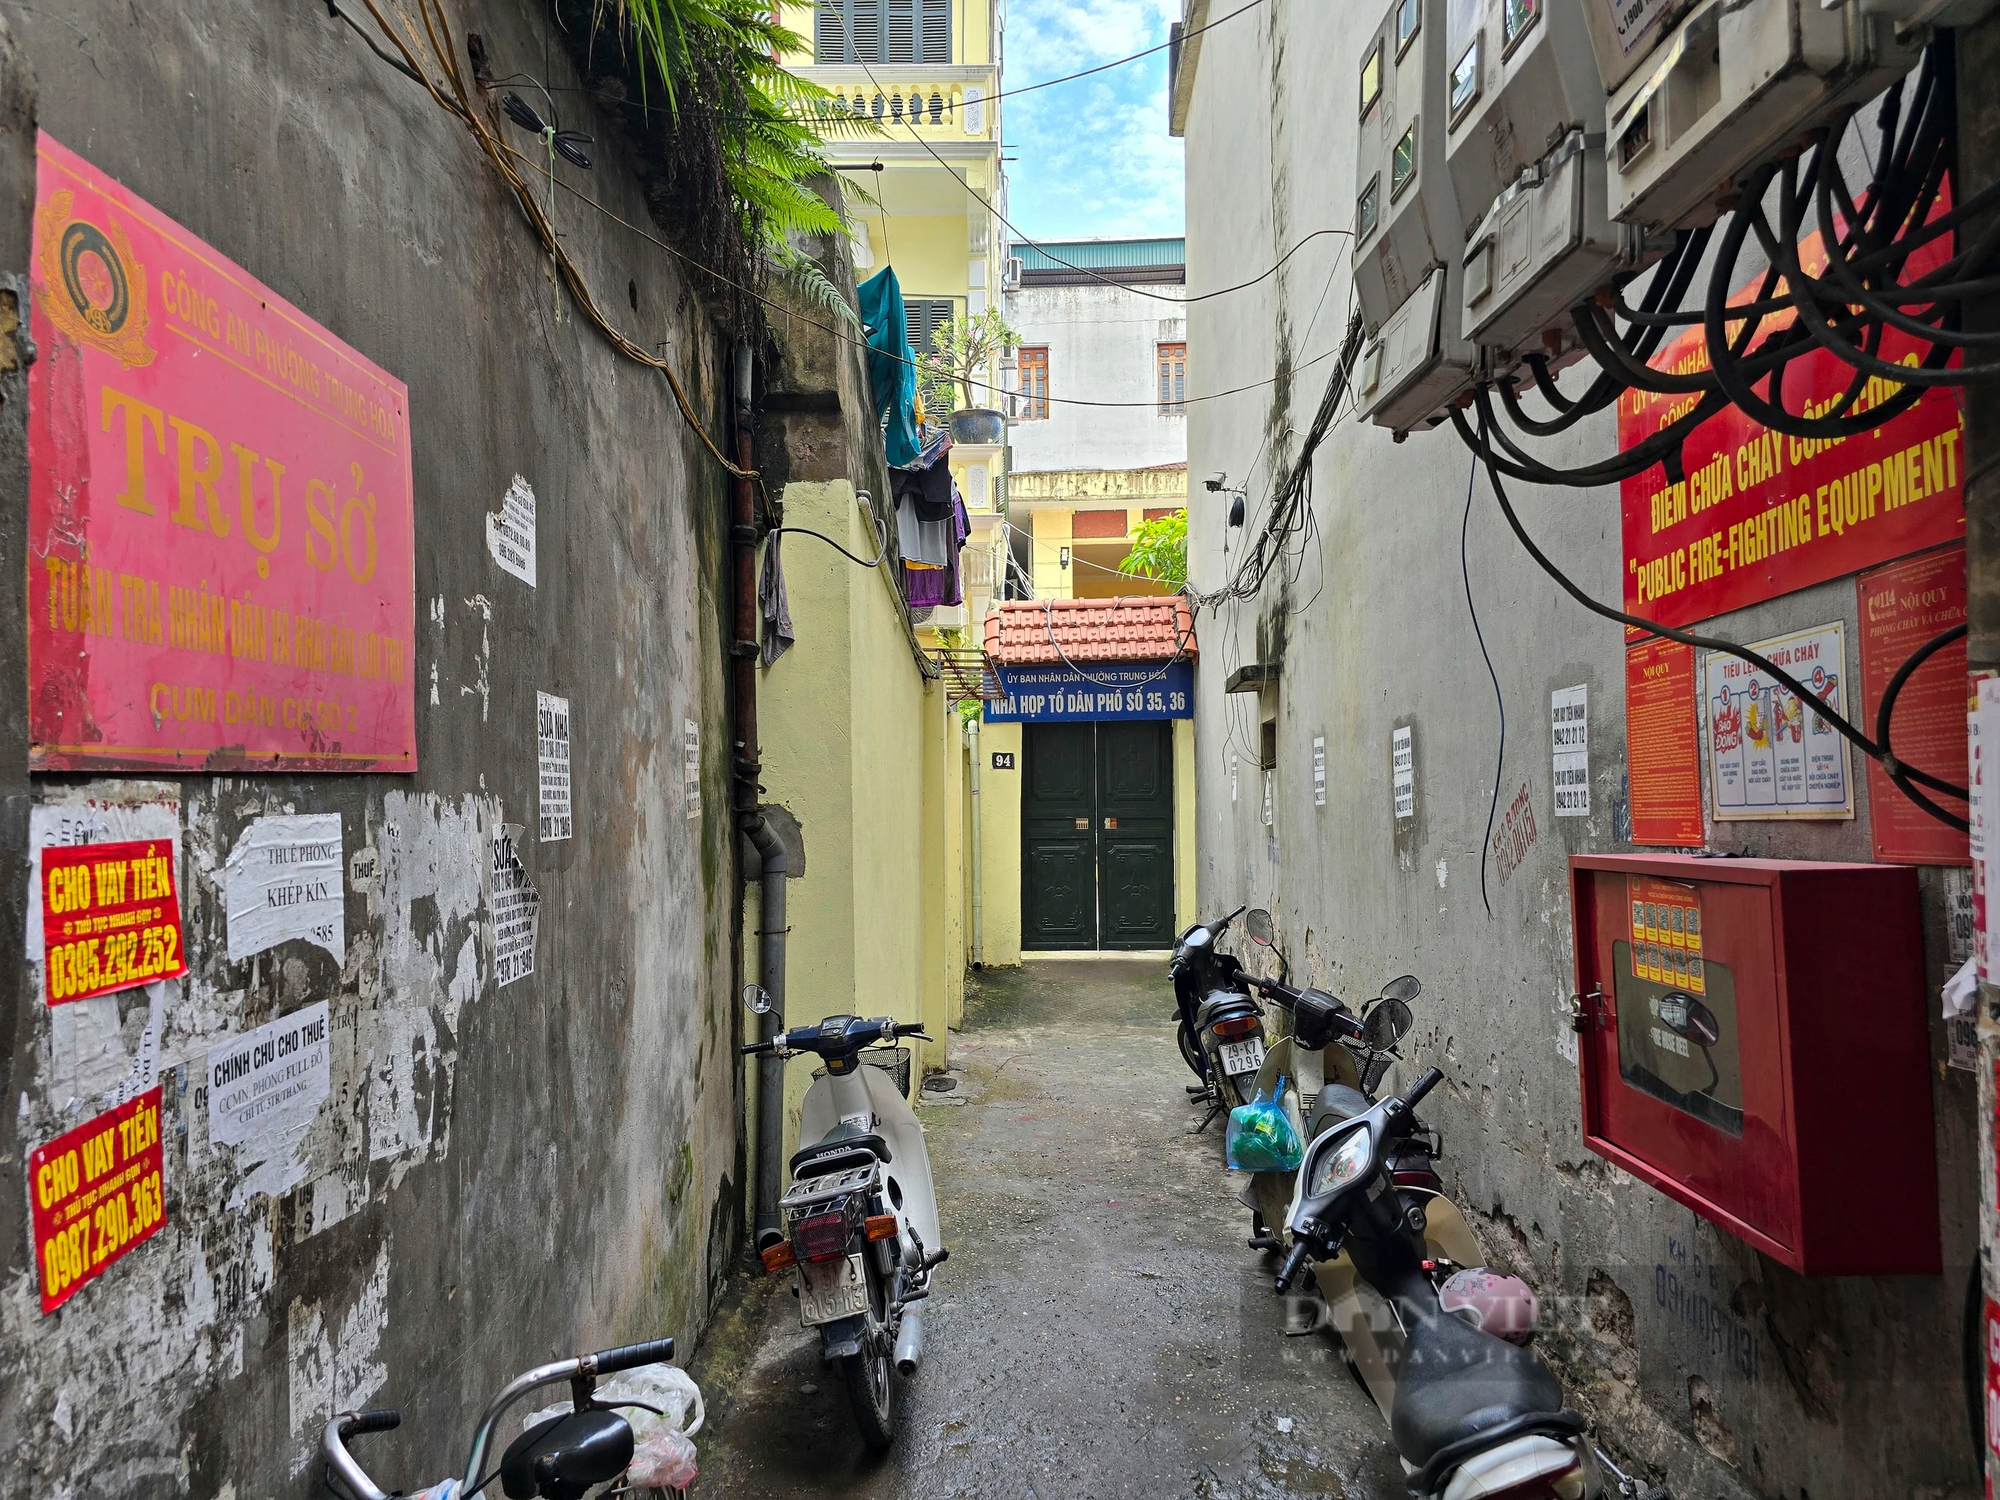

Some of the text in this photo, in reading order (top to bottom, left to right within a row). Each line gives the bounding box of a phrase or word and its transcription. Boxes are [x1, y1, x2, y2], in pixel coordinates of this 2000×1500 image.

[161, 268, 396, 444] CÔNG AN PHƯỜNG TRUNG HÒA
[102, 384, 378, 585] TRỤ SỞ
[1690, 449, 1733, 515] CHỮA
[1736, 423, 1782, 492] CHÁY
[1689, 493, 1810, 584] FIRE-FIGHTING
[1880, 588, 1896, 609] 114
[1901, 586, 1948, 611] NỘI QUY
[120, 573, 163, 646] TRA
[169, 579, 225, 655] NHÂN
[230, 590, 267, 663] DÂN
[1869, 606, 1960, 637] PHÒNG CHÁY VÀ CHỮA
[1794, 640, 1820, 663] CHÁY
[1007, 672, 1019, 684] ỦY
[1020, 674, 1037, 684] BAN
[1038, 671, 1061, 684] NHÂN
[1063, 671, 1081, 683] DÂN
[1118, 671, 1147, 682] TRUNG
[1148, 669, 1167, 680] HÒA
[1655, 661, 1670, 677] QUY
[1814, 669, 1823, 684] 4
[990, 686, 1186, 718] NHÀ HỌP TỔ DÂN PHỐ SỐ 35, 36
[1750, 682, 1757, 696] 2
[150, 682, 216, 734] CỤM
[224, 684, 276, 729] DÂN
[345, 705, 358, 734] 2
[539, 697, 569, 742] SỬA NHÀ
[1718, 717, 1732, 732] BÁO
[995, 755, 1011, 767] 94
[268, 841, 336, 865] THUÊ PHÒNG
[49, 843, 171, 914] CHO VAY TIỀN
[267, 876, 329, 908] KHÉP KÍN
[74, 908, 152, 935] THỦ TỤC NHANH GỌN
[51, 924, 181, 999] 0395.292.252
[214, 1013, 325, 1088] CHÍNH CHỦ CHO THUÊ
[1228, 1041, 1256, 1059] 29-K7
[1229, 1055, 1262, 1072] 0296
[253, 1067, 284, 1098] PHÒNG
[286, 1058, 310, 1080] FULL
[310, 1044, 324, 1067] ĐỒ
[38, 1099, 158, 1210] CHO VAY TIỀN
[816, 1146, 853, 1160] HONDA
[64, 1162, 141, 1220] THỦ TỤC NHANH GỌN
[44, 1170, 162, 1297] 0987.290.363
